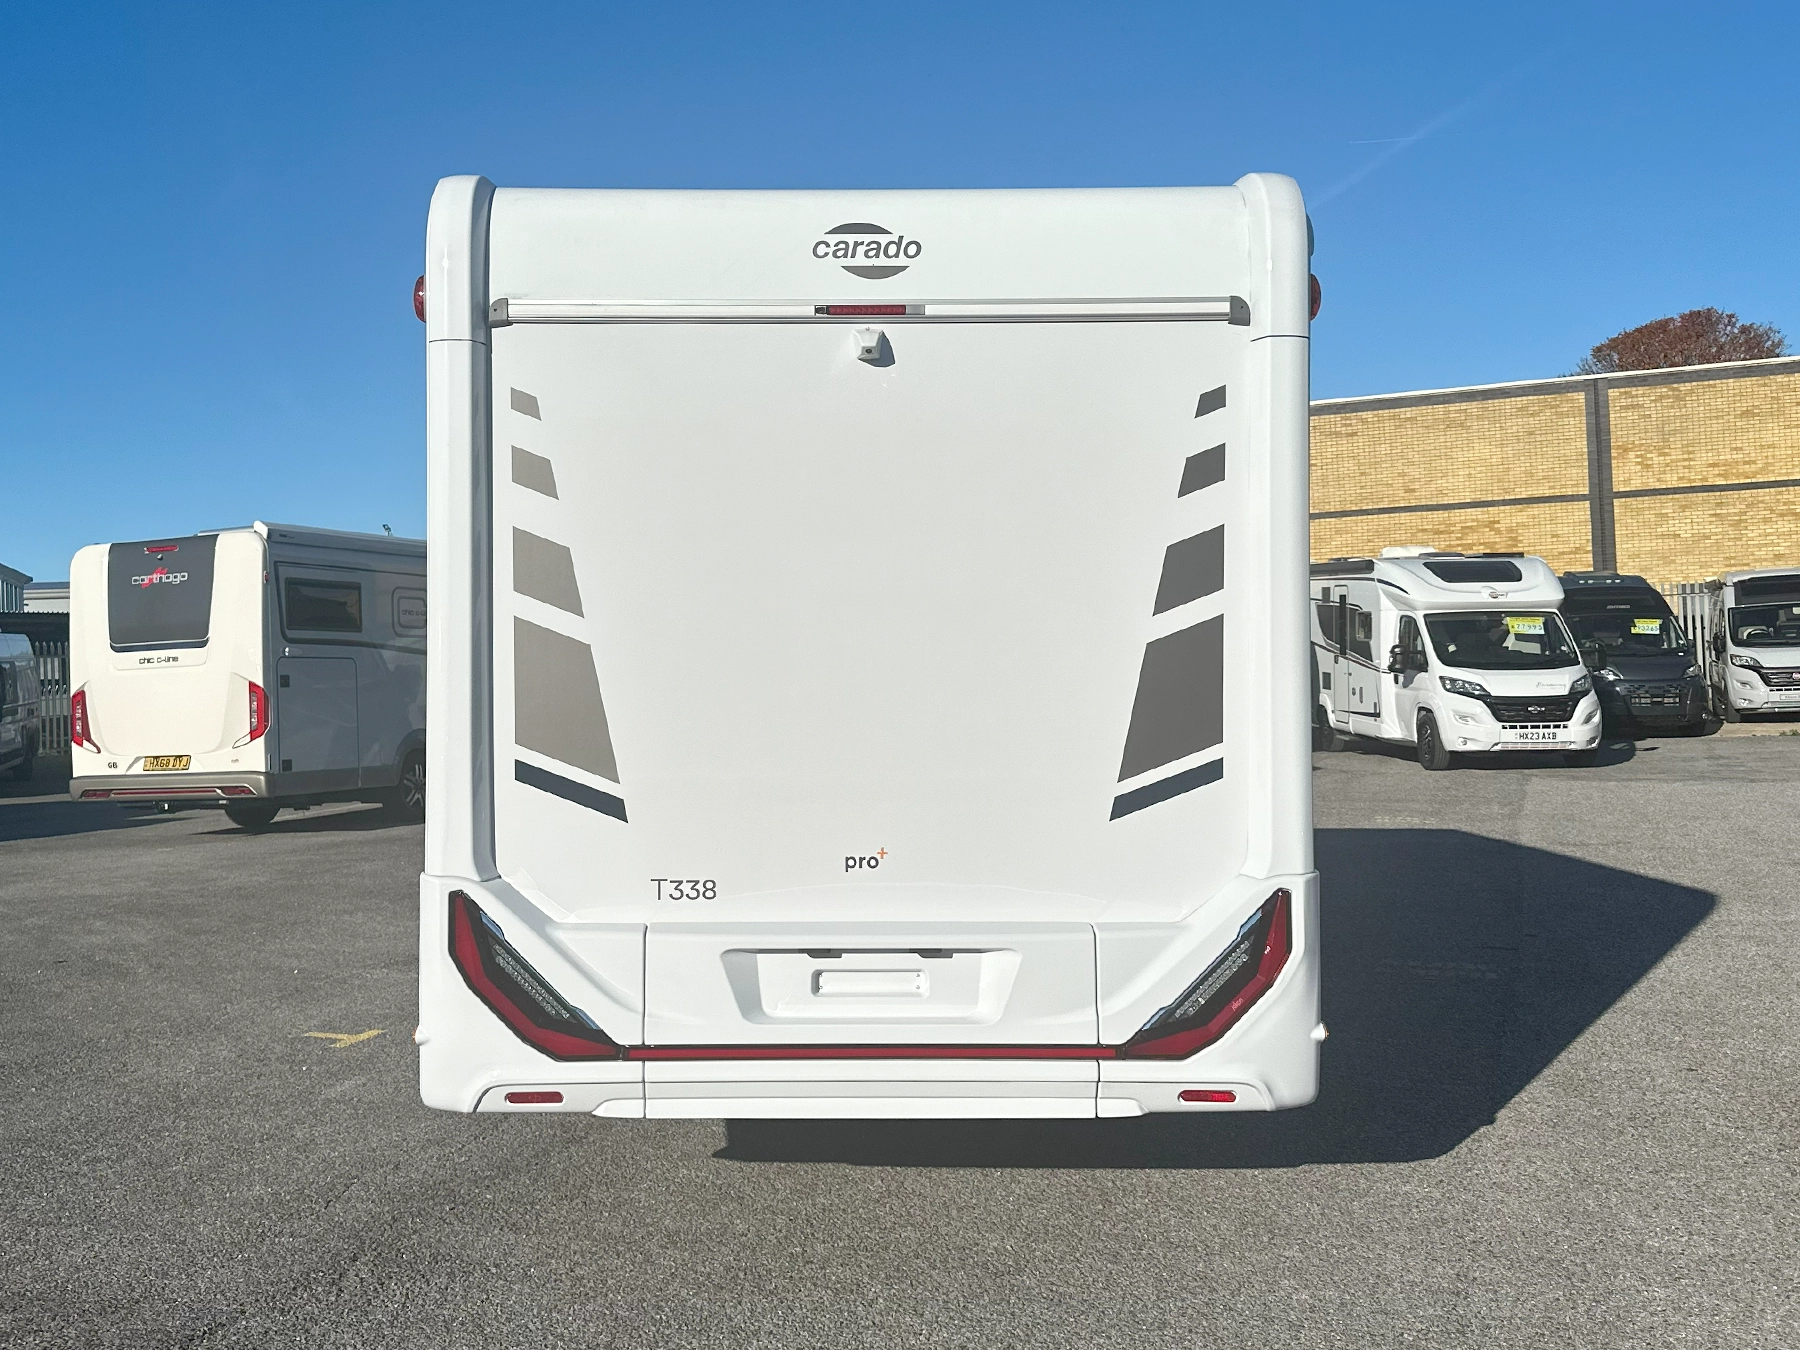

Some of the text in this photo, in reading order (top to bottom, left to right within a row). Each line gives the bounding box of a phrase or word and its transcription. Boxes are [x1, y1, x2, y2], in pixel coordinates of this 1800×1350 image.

[812, 235, 922, 259] carado
[131, 572, 189, 585] carthago
[1519, 732, 1540, 740] HX23
[650, 878, 717, 901] T338
